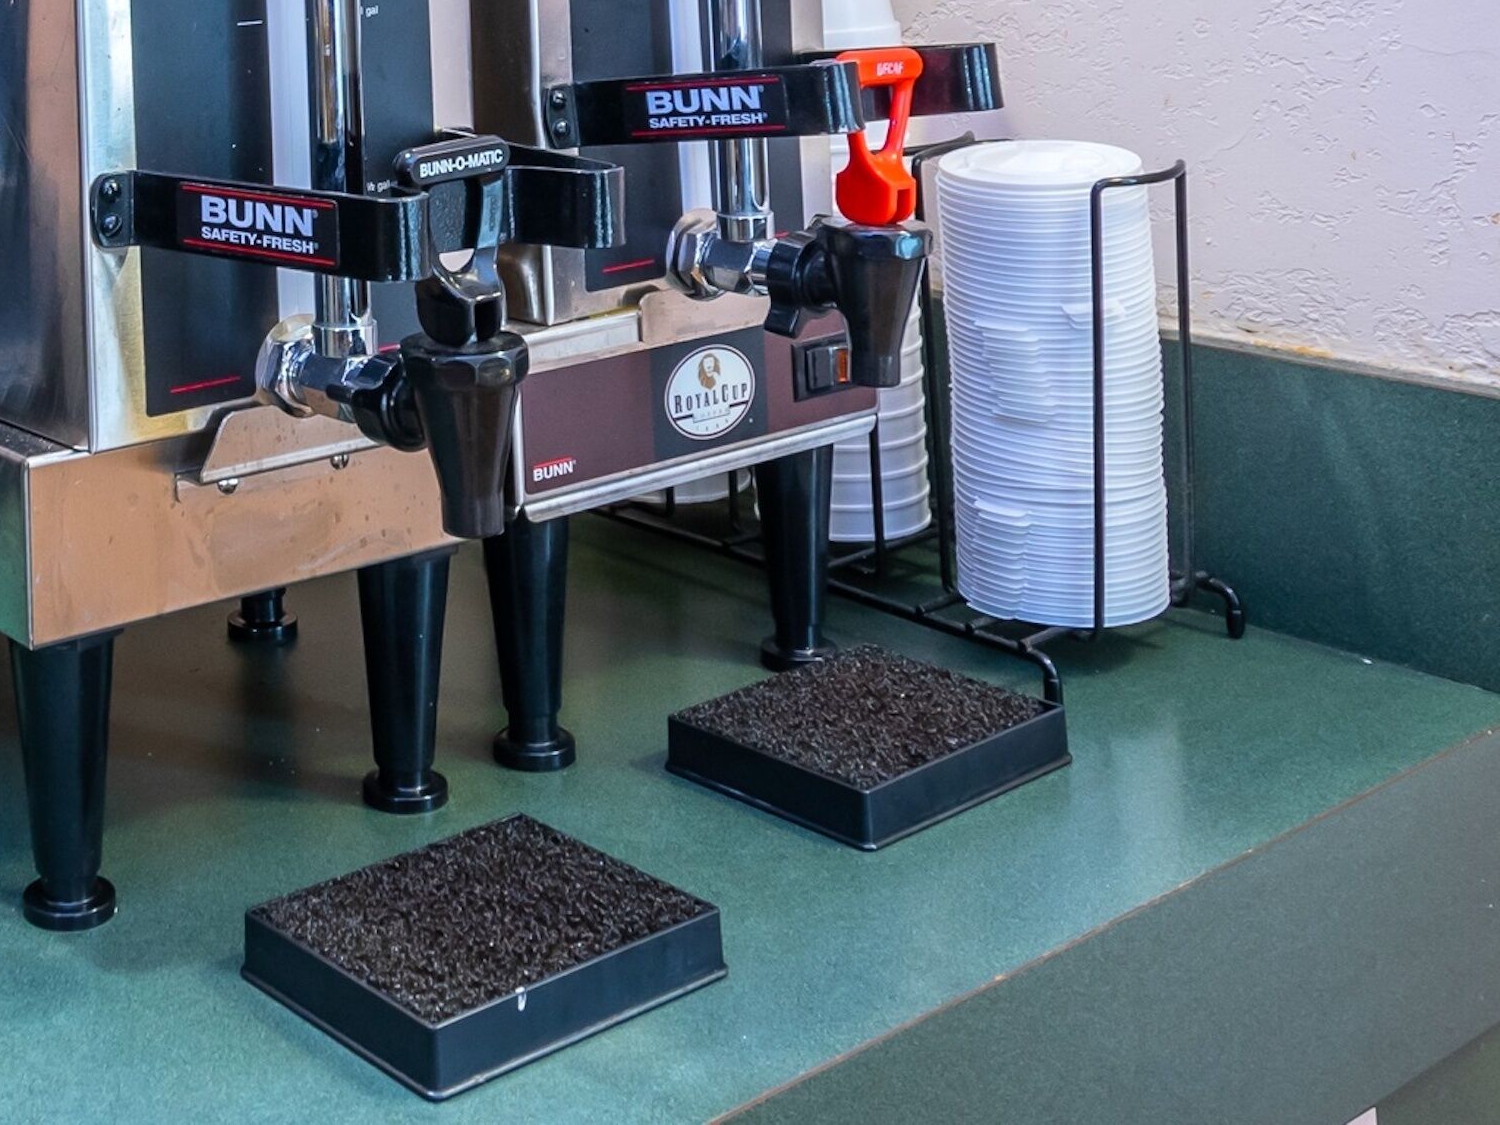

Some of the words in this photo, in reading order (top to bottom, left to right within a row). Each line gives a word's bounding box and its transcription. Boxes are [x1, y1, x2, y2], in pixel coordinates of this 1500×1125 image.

[365, 5, 378, 18] gal
[645, 85, 761, 115] BUNN
[649, 113, 764, 128] SAFETY-FRESH
[420, 149, 503, 178] BUNN-O-MATIC
[377, 180, 391, 192] gal
[201, 195, 313, 237] BUNN
[201, 226, 315, 254] SAFETY-FRESH
[533, 460, 573, 482] BUNN
